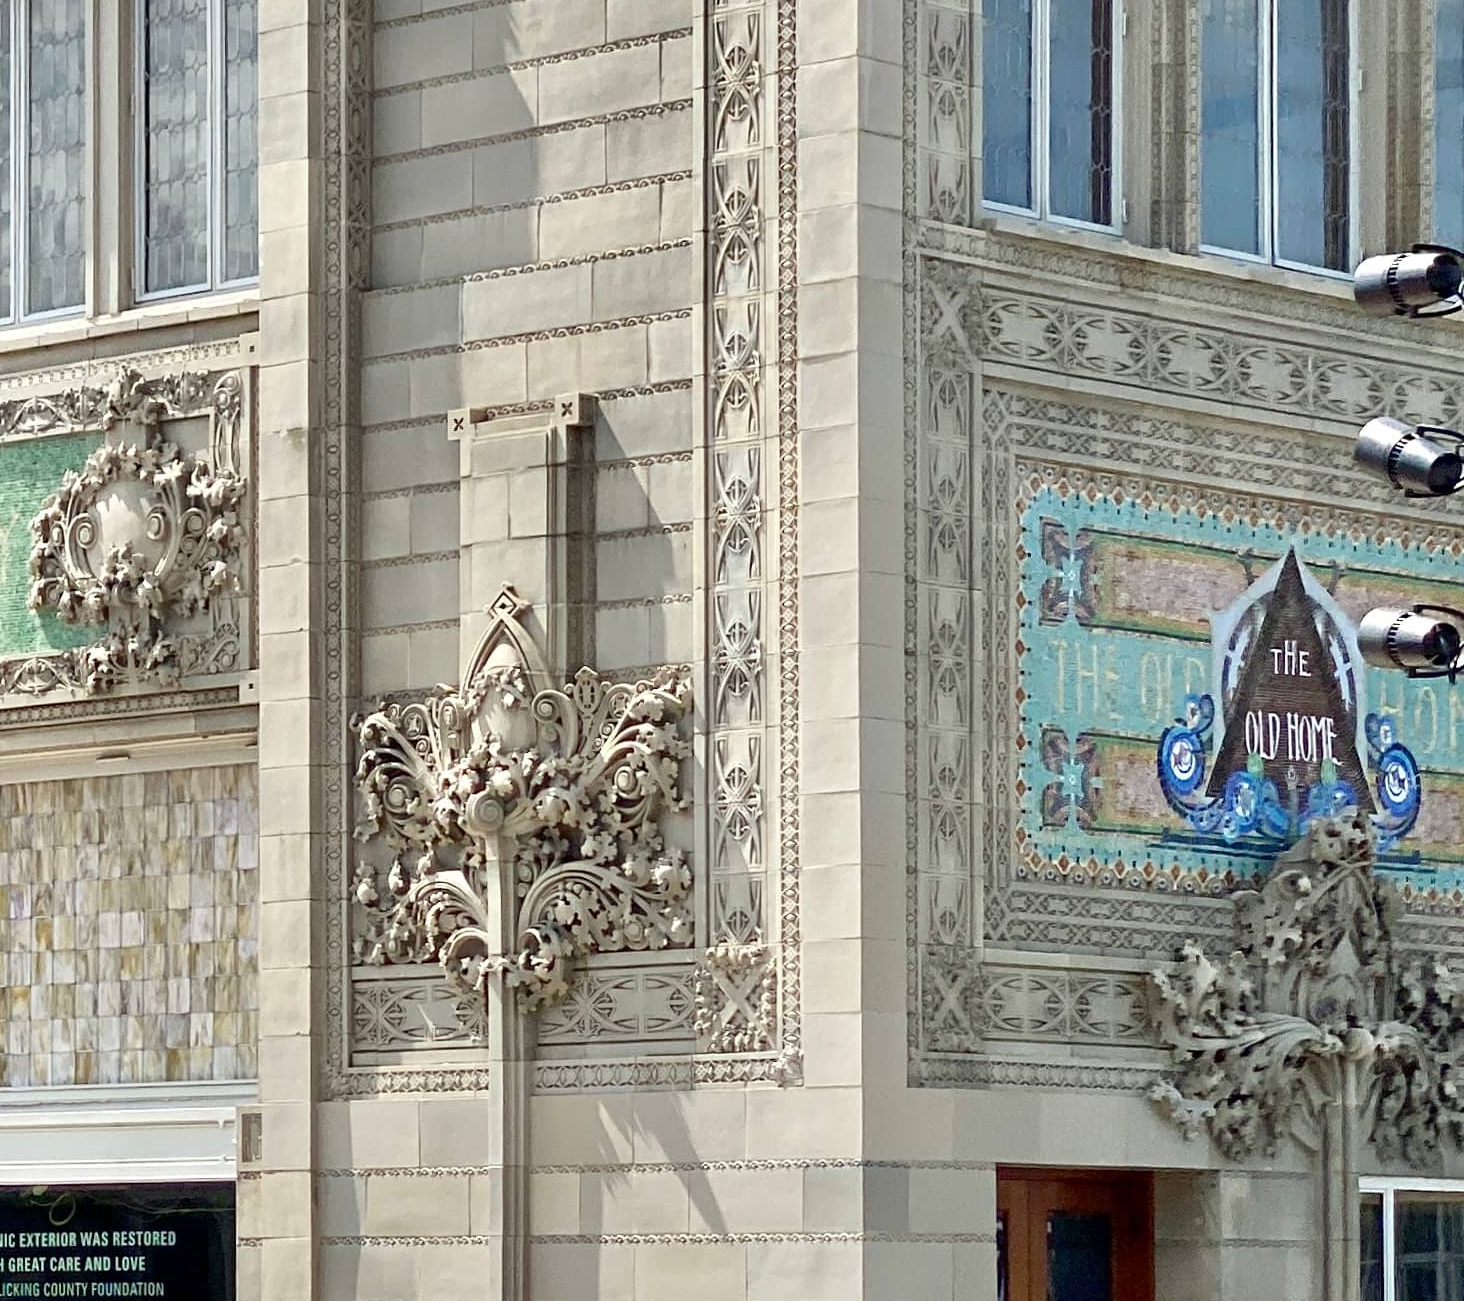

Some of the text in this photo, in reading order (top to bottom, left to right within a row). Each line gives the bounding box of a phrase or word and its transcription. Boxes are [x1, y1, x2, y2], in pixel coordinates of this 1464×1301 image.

[1270, 639, 1312, 677] THE
[1048, 638, 1124, 720] THE
[1245, 709, 1344, 766] OLD HOME
[19, 1232, 77, 1248] EXTERIOR
[80, 1231, 109, 1247] WAS
[112, 1230, 177, 1247] RESTORED
[8, 1257, 47, 1273] GREAT
[49, 1256, 81, 1272] CARE
[84, 1256, 111, 1272] AND
[114, 1256, 146, 1272] LOVE
[43, 1282, 88, 1297] COUNTY
[91, 1281, 165, 1297] FOUNDATION
